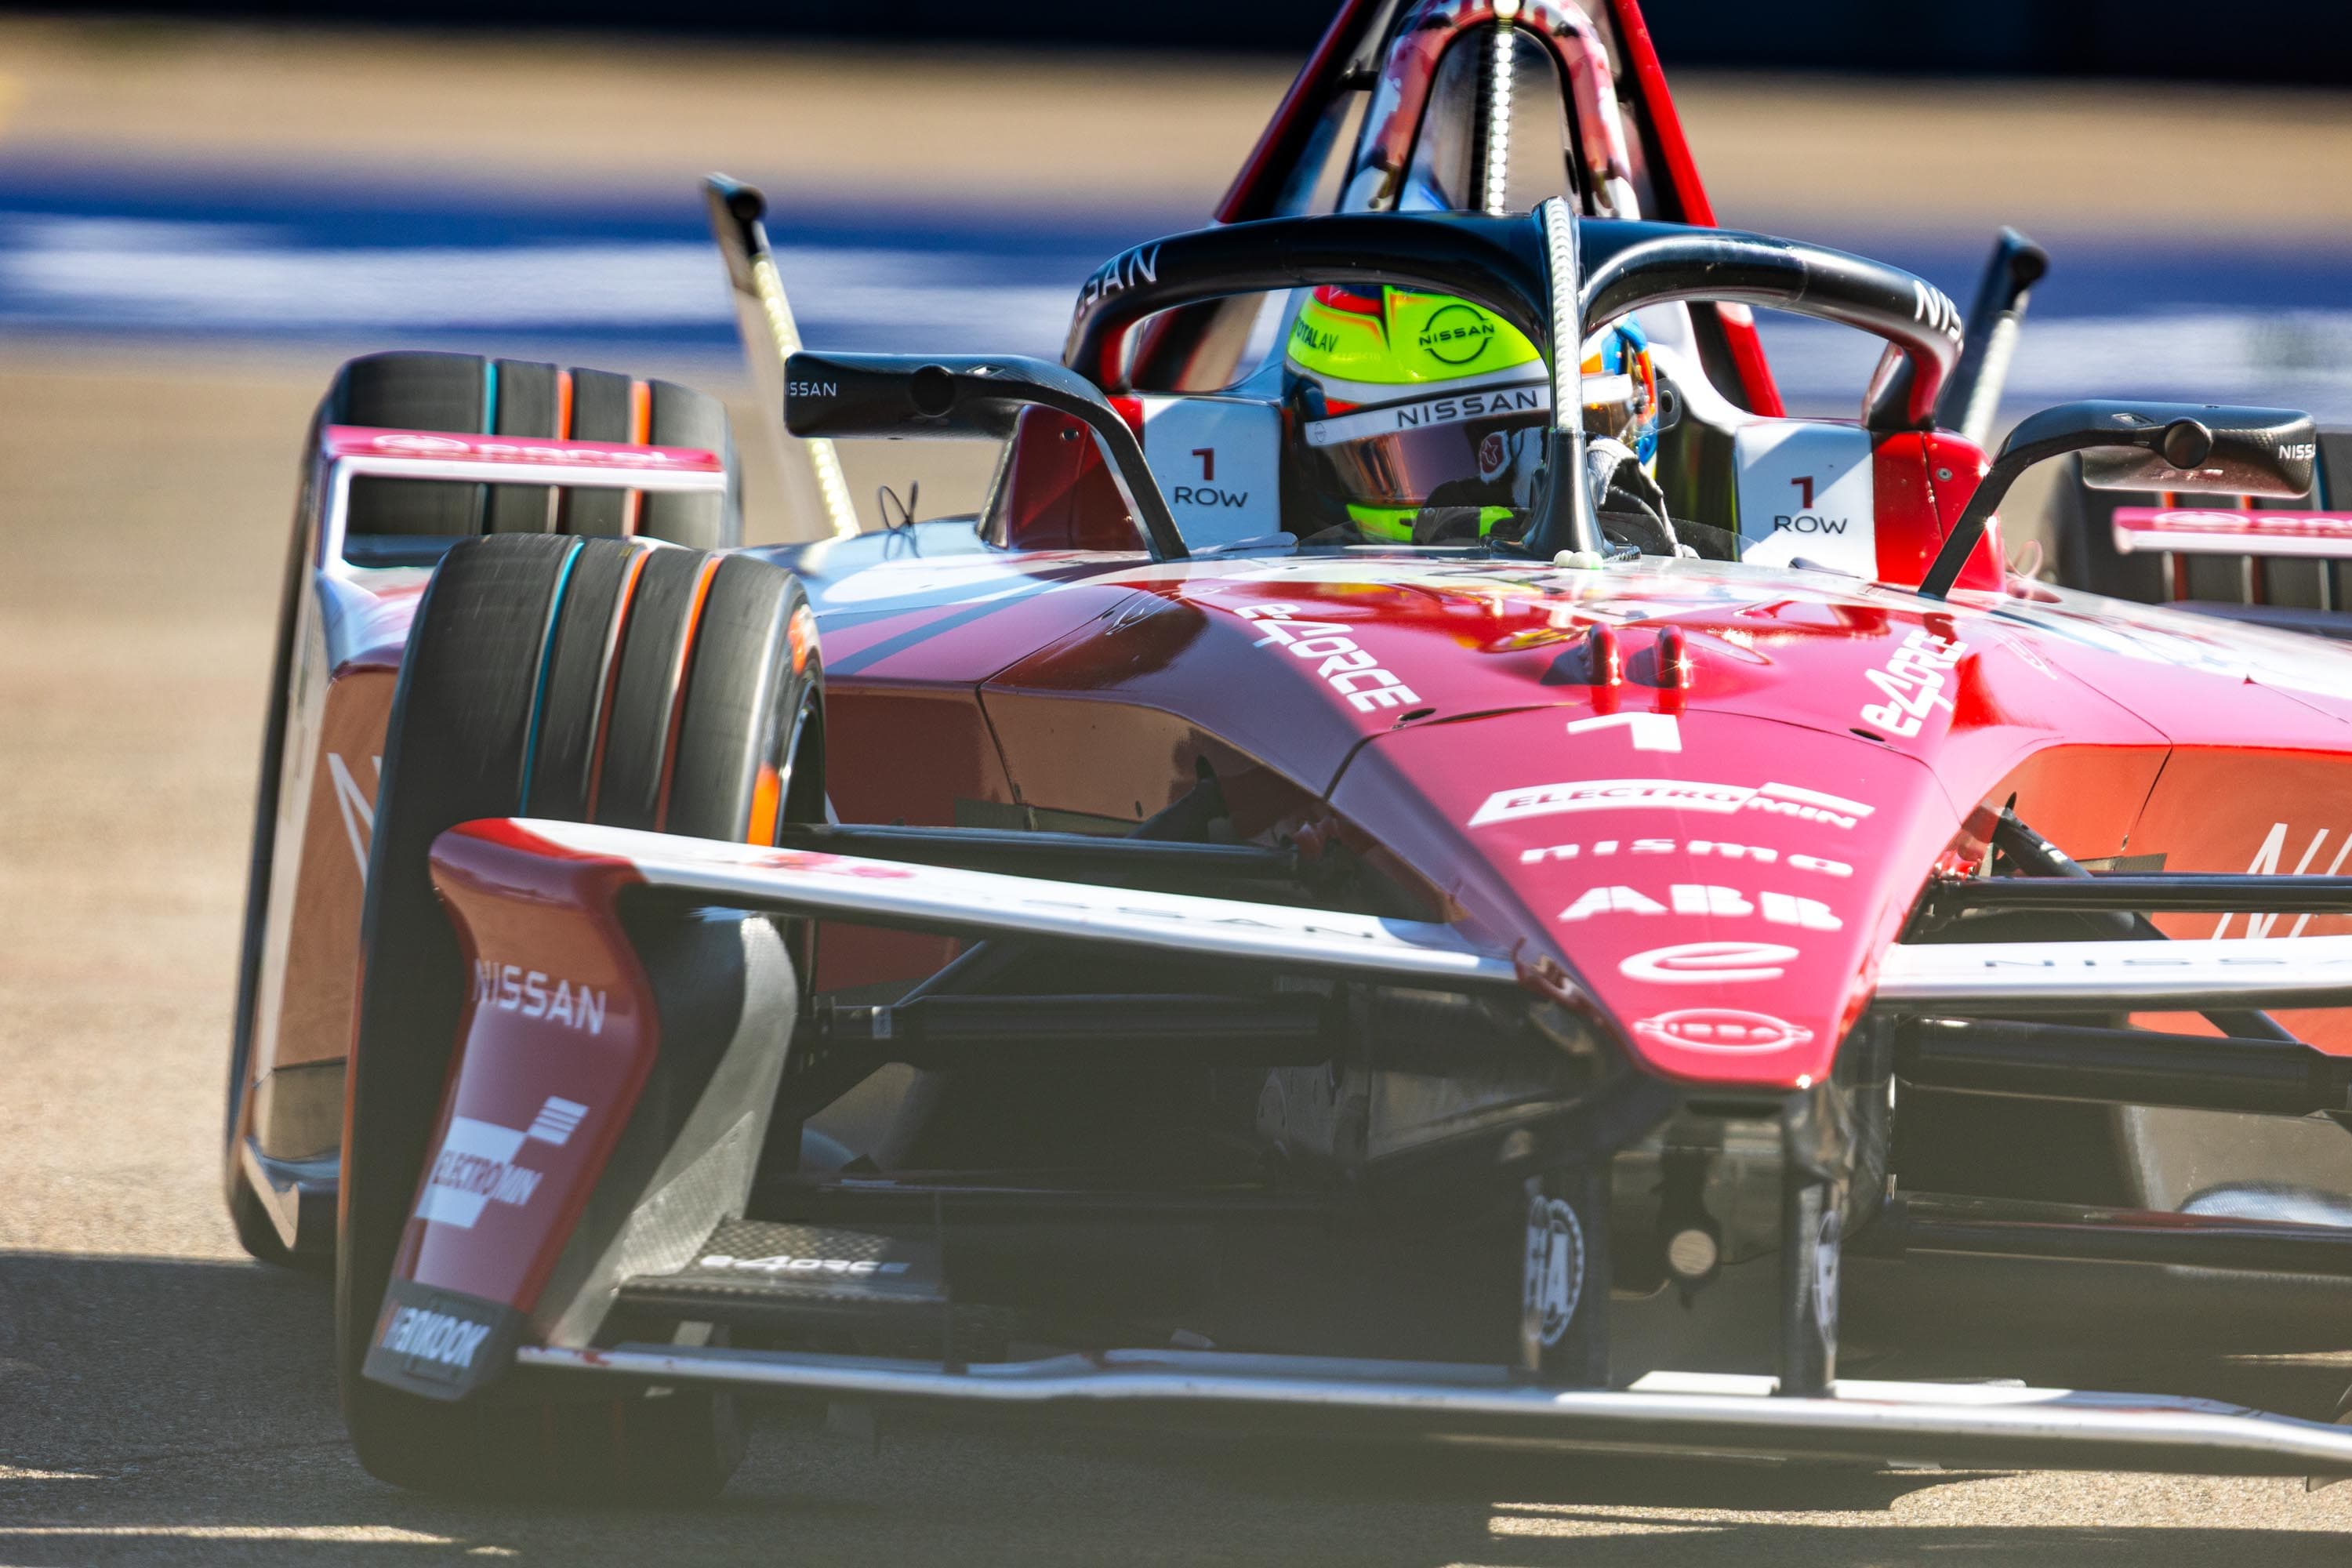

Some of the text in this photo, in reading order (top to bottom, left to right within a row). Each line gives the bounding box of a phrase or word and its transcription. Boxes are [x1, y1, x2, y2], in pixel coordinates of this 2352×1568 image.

[1419, 324, 1494, 346] NISSAN
[1397, 390, 1539, 427] NISSAN
[1191, 447, 1214, 481] 1
[1174, 486, 1248, 507] ROW
[1791, 475, 1813, 509] 1
[1774, 515, 1847, 534] ROW
[1557, 884, 1843, 931] ABB
[472, 958, 606, 1036] NISSAN
